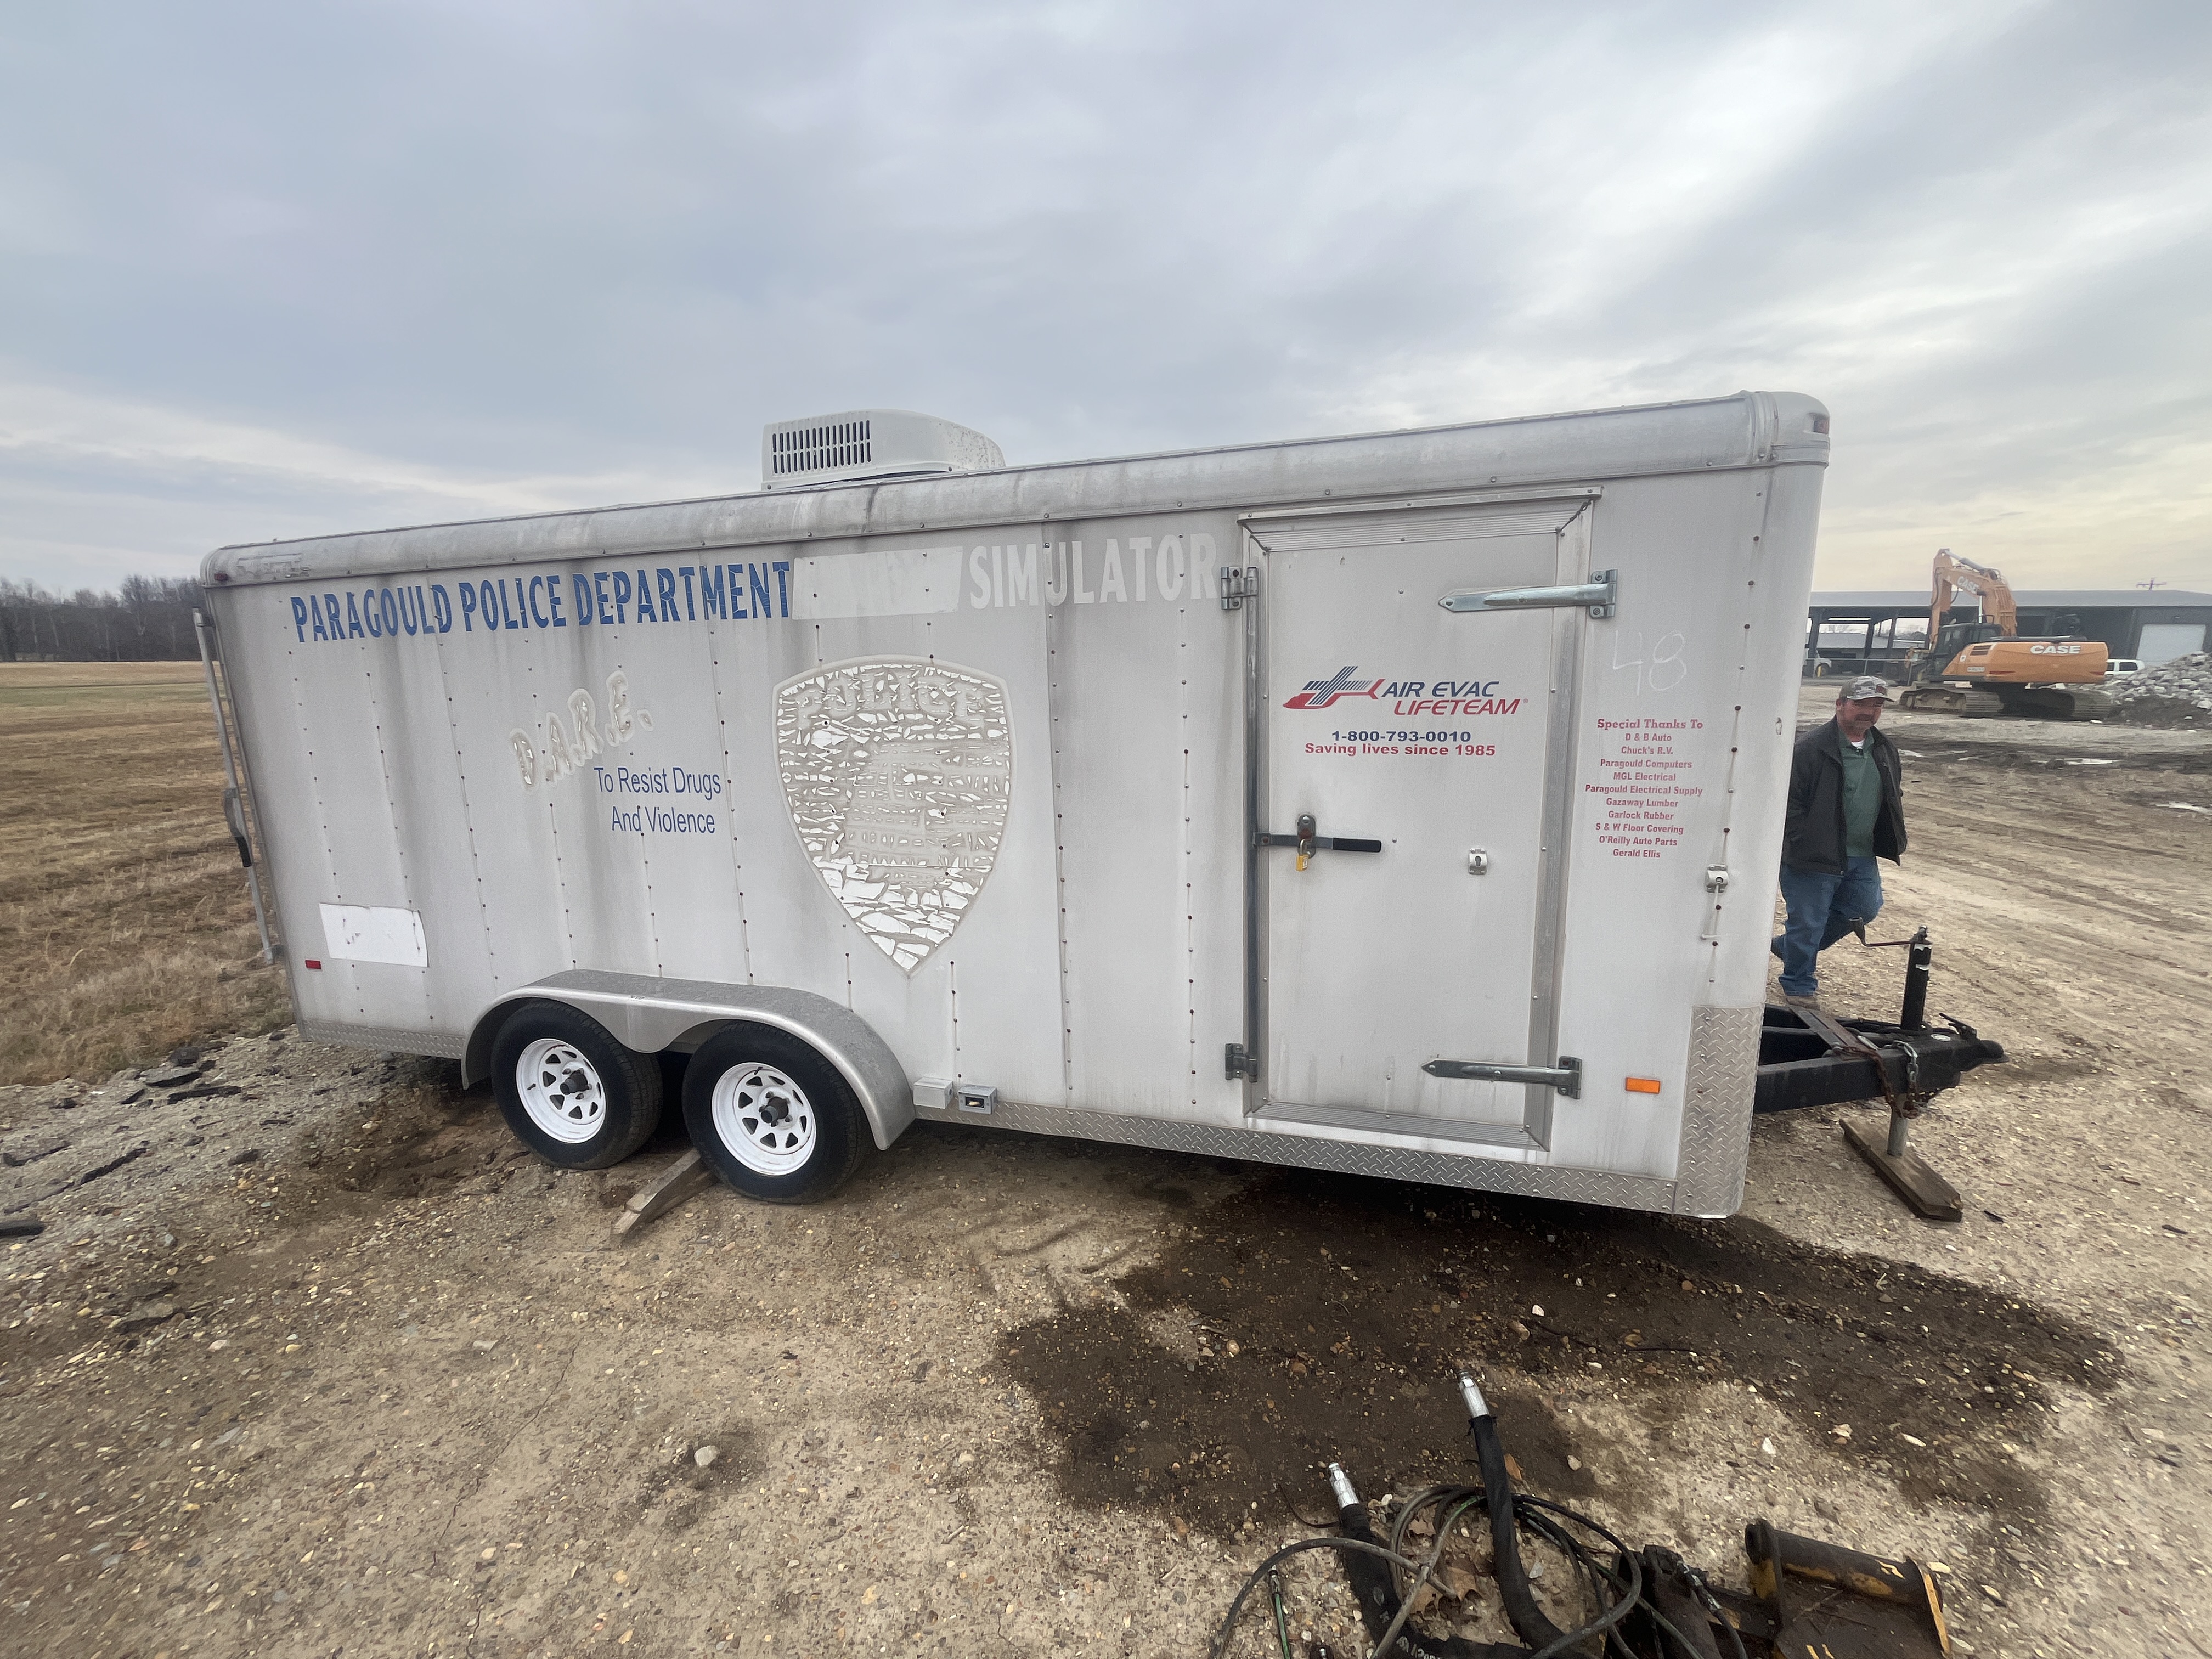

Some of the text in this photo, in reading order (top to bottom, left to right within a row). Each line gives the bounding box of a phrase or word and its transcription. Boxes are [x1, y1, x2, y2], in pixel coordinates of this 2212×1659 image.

[969, 533, 1220, 610] SIMULATOR
[1957, 576, 1979, 594] CASE
[290, 561, 789, 642] PARAGOULD POLICE DEPARTMENT
[2030, 645, 2080, 654] CASE
[1613, 630, 1687, 696] 48
[1382, 681, 1499, 697] AIR EVAC
[1394, 699, 1520, 715] LIFETEAM
[1598, 719, 1703, 730] Special Thanks To
[1331, 731, 1471, 742] 1-800-793-0010
[1305, 743, 1496, 756] Saving lives since 1985
[1621, 746, 1654, 754] Chuck's
[1600, 759, 1692, 769] Paragould Computers
[594, 767, 721, 800] To Resist Drugs
[1585, 785, 1703, 796] Paragould Electrical Supply
[1606, 798, 1644, 808] Gazaway
[612, 806, 715, 833] And Violence
[1647, 825, 1684, 835] Covering
[1599, 836, 1630, 845] O'Reilly
[1613, 849, 1640, 857] Gerald
